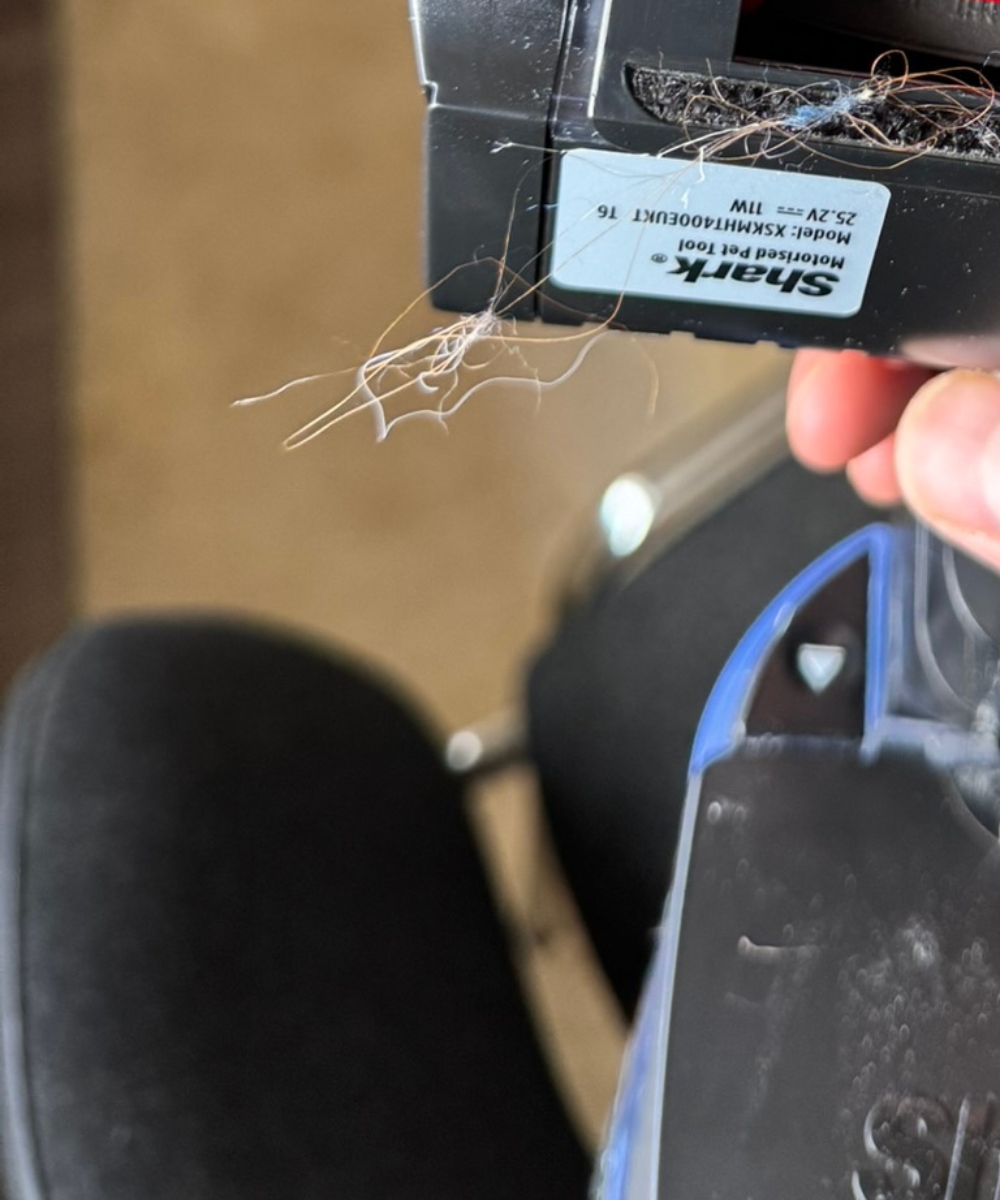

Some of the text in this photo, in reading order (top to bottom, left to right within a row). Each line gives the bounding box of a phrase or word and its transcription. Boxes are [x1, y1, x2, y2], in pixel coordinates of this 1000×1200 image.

[597, 204, 852, 245] Model: XSKMHT400EUKT T6
[729, 198, 858, 227] 25.2V 11W
[678, 238, 846, 270] Motorised Pet Tool
